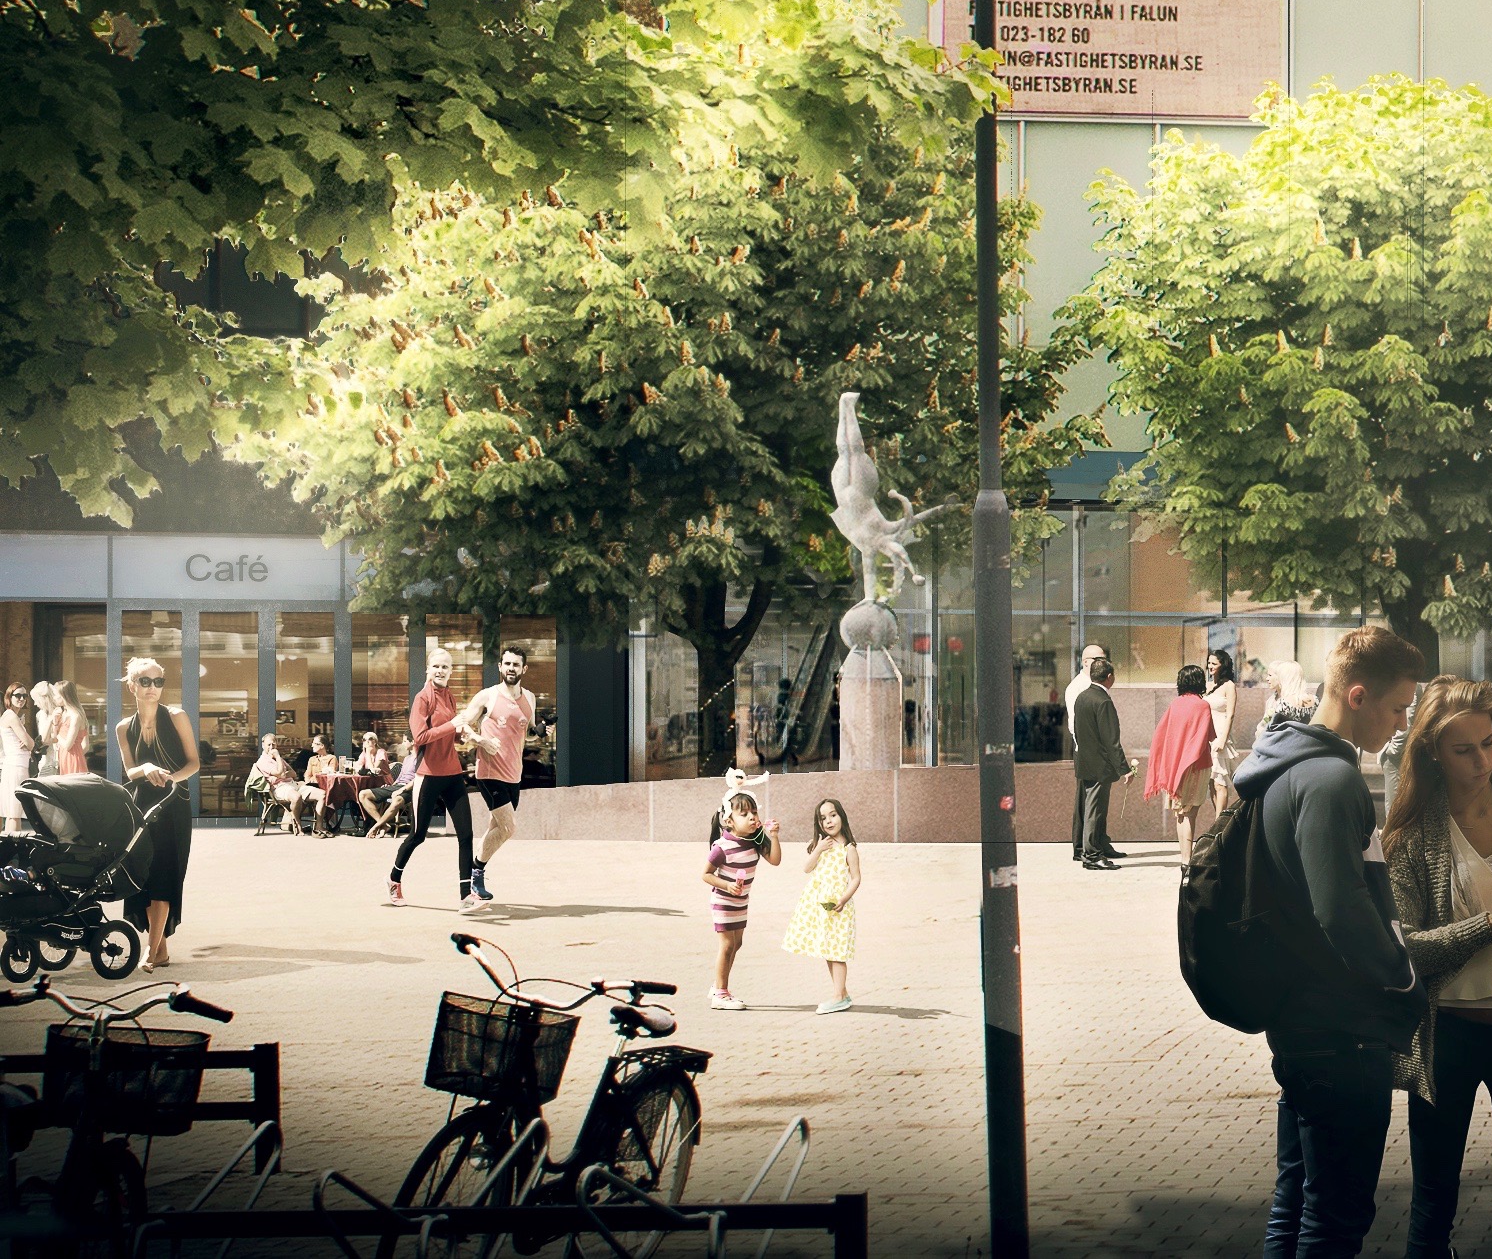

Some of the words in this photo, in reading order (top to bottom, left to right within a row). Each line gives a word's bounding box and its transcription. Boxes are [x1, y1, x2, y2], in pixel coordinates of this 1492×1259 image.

[968, 0, 1114, 20] FTIGHETSBYRÅN
[1119, 4, 1125, 21] I
[1130, 4, 1179, 22] FALUN
[1000, 25, 1067, 43] 023-182
[1071, 27, 1091, 44] 60
[998, 75, 1138, 94] TIGHETSBYRAN.SE
[185, 553, 269, 583] Café
